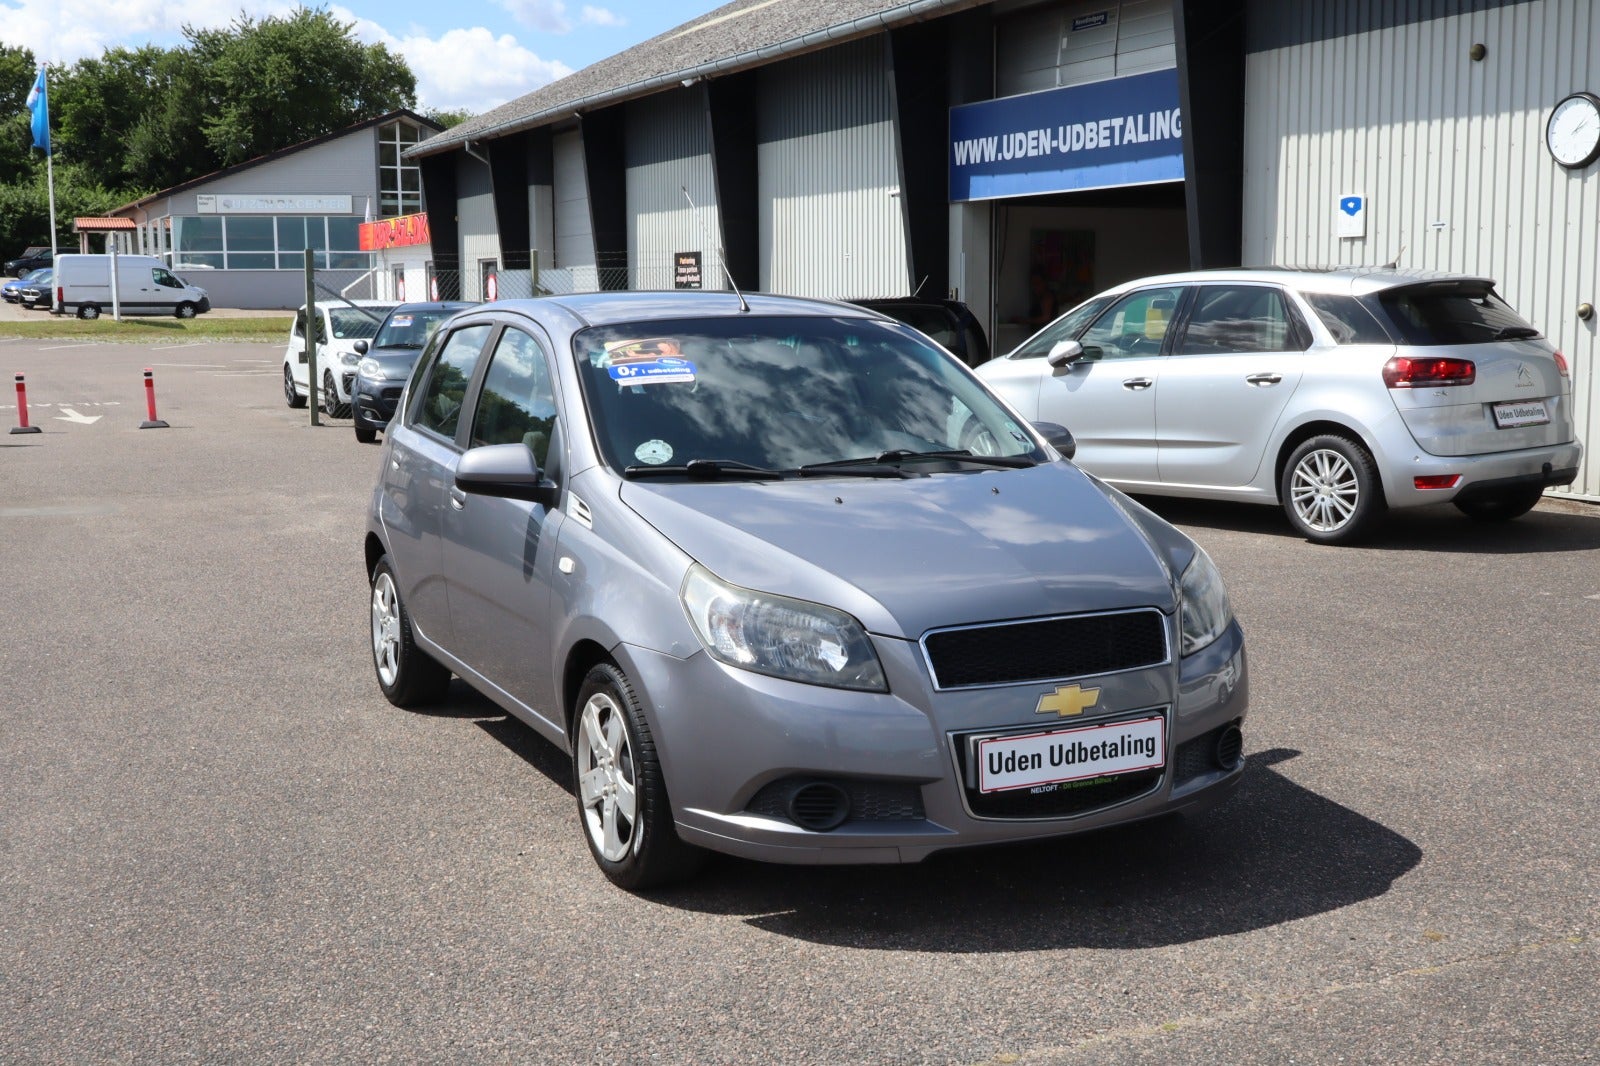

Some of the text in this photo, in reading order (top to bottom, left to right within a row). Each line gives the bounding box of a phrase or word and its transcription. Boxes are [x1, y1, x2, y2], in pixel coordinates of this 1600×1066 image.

[988, 735, 1156, 775] Uden Udbetaling
[1031, 784, 1058, 794] NELTOFT
